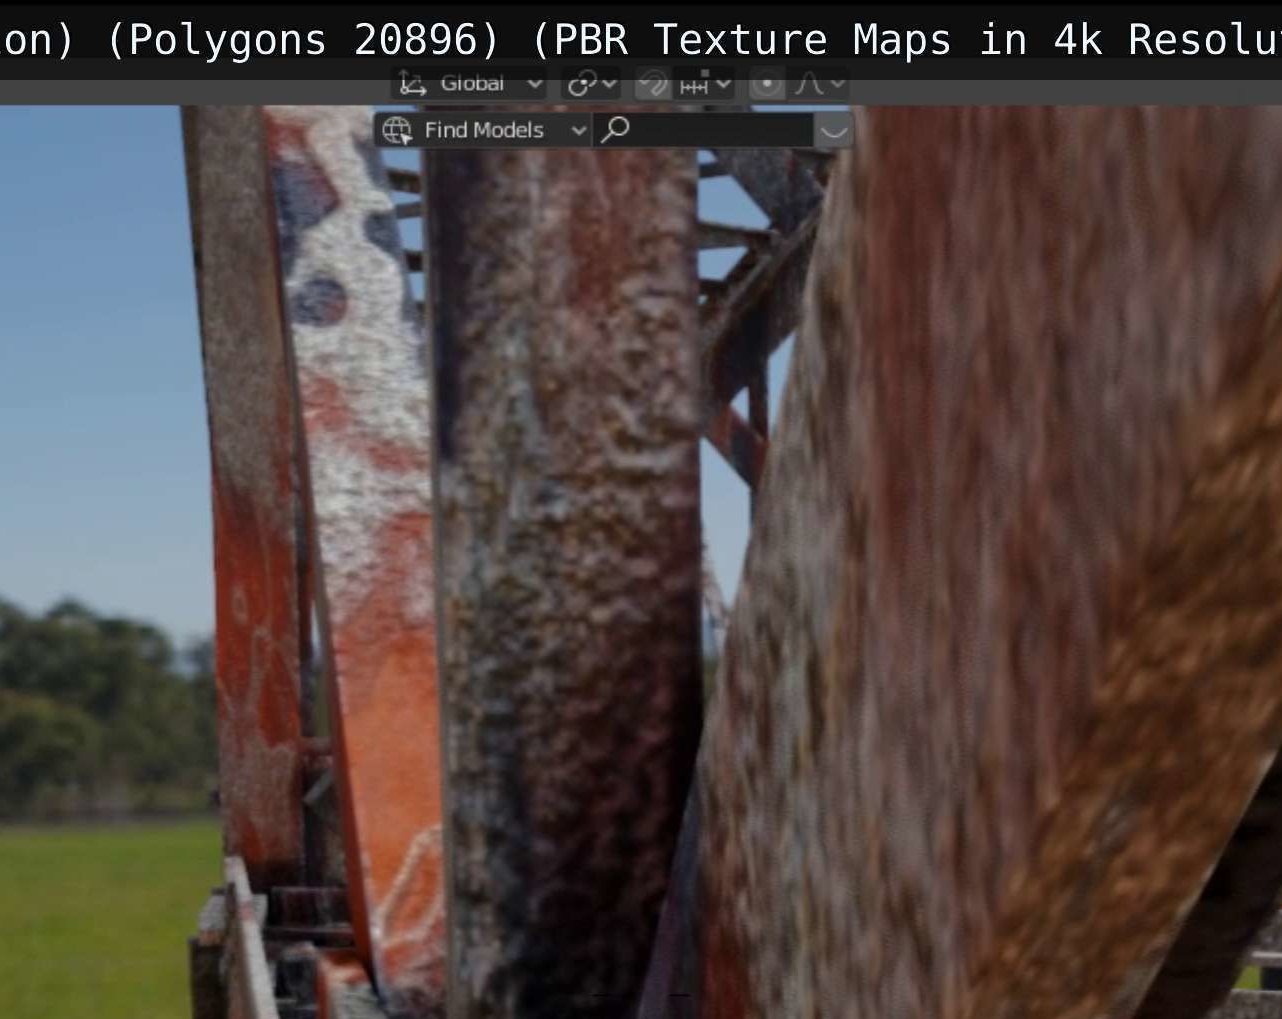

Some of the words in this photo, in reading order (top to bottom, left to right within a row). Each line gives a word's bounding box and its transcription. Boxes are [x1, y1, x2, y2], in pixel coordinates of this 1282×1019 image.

[440, 74, 505, 92] Global
[426, 121, 468, 138] Find
[474, 121, 544, 138] Models
